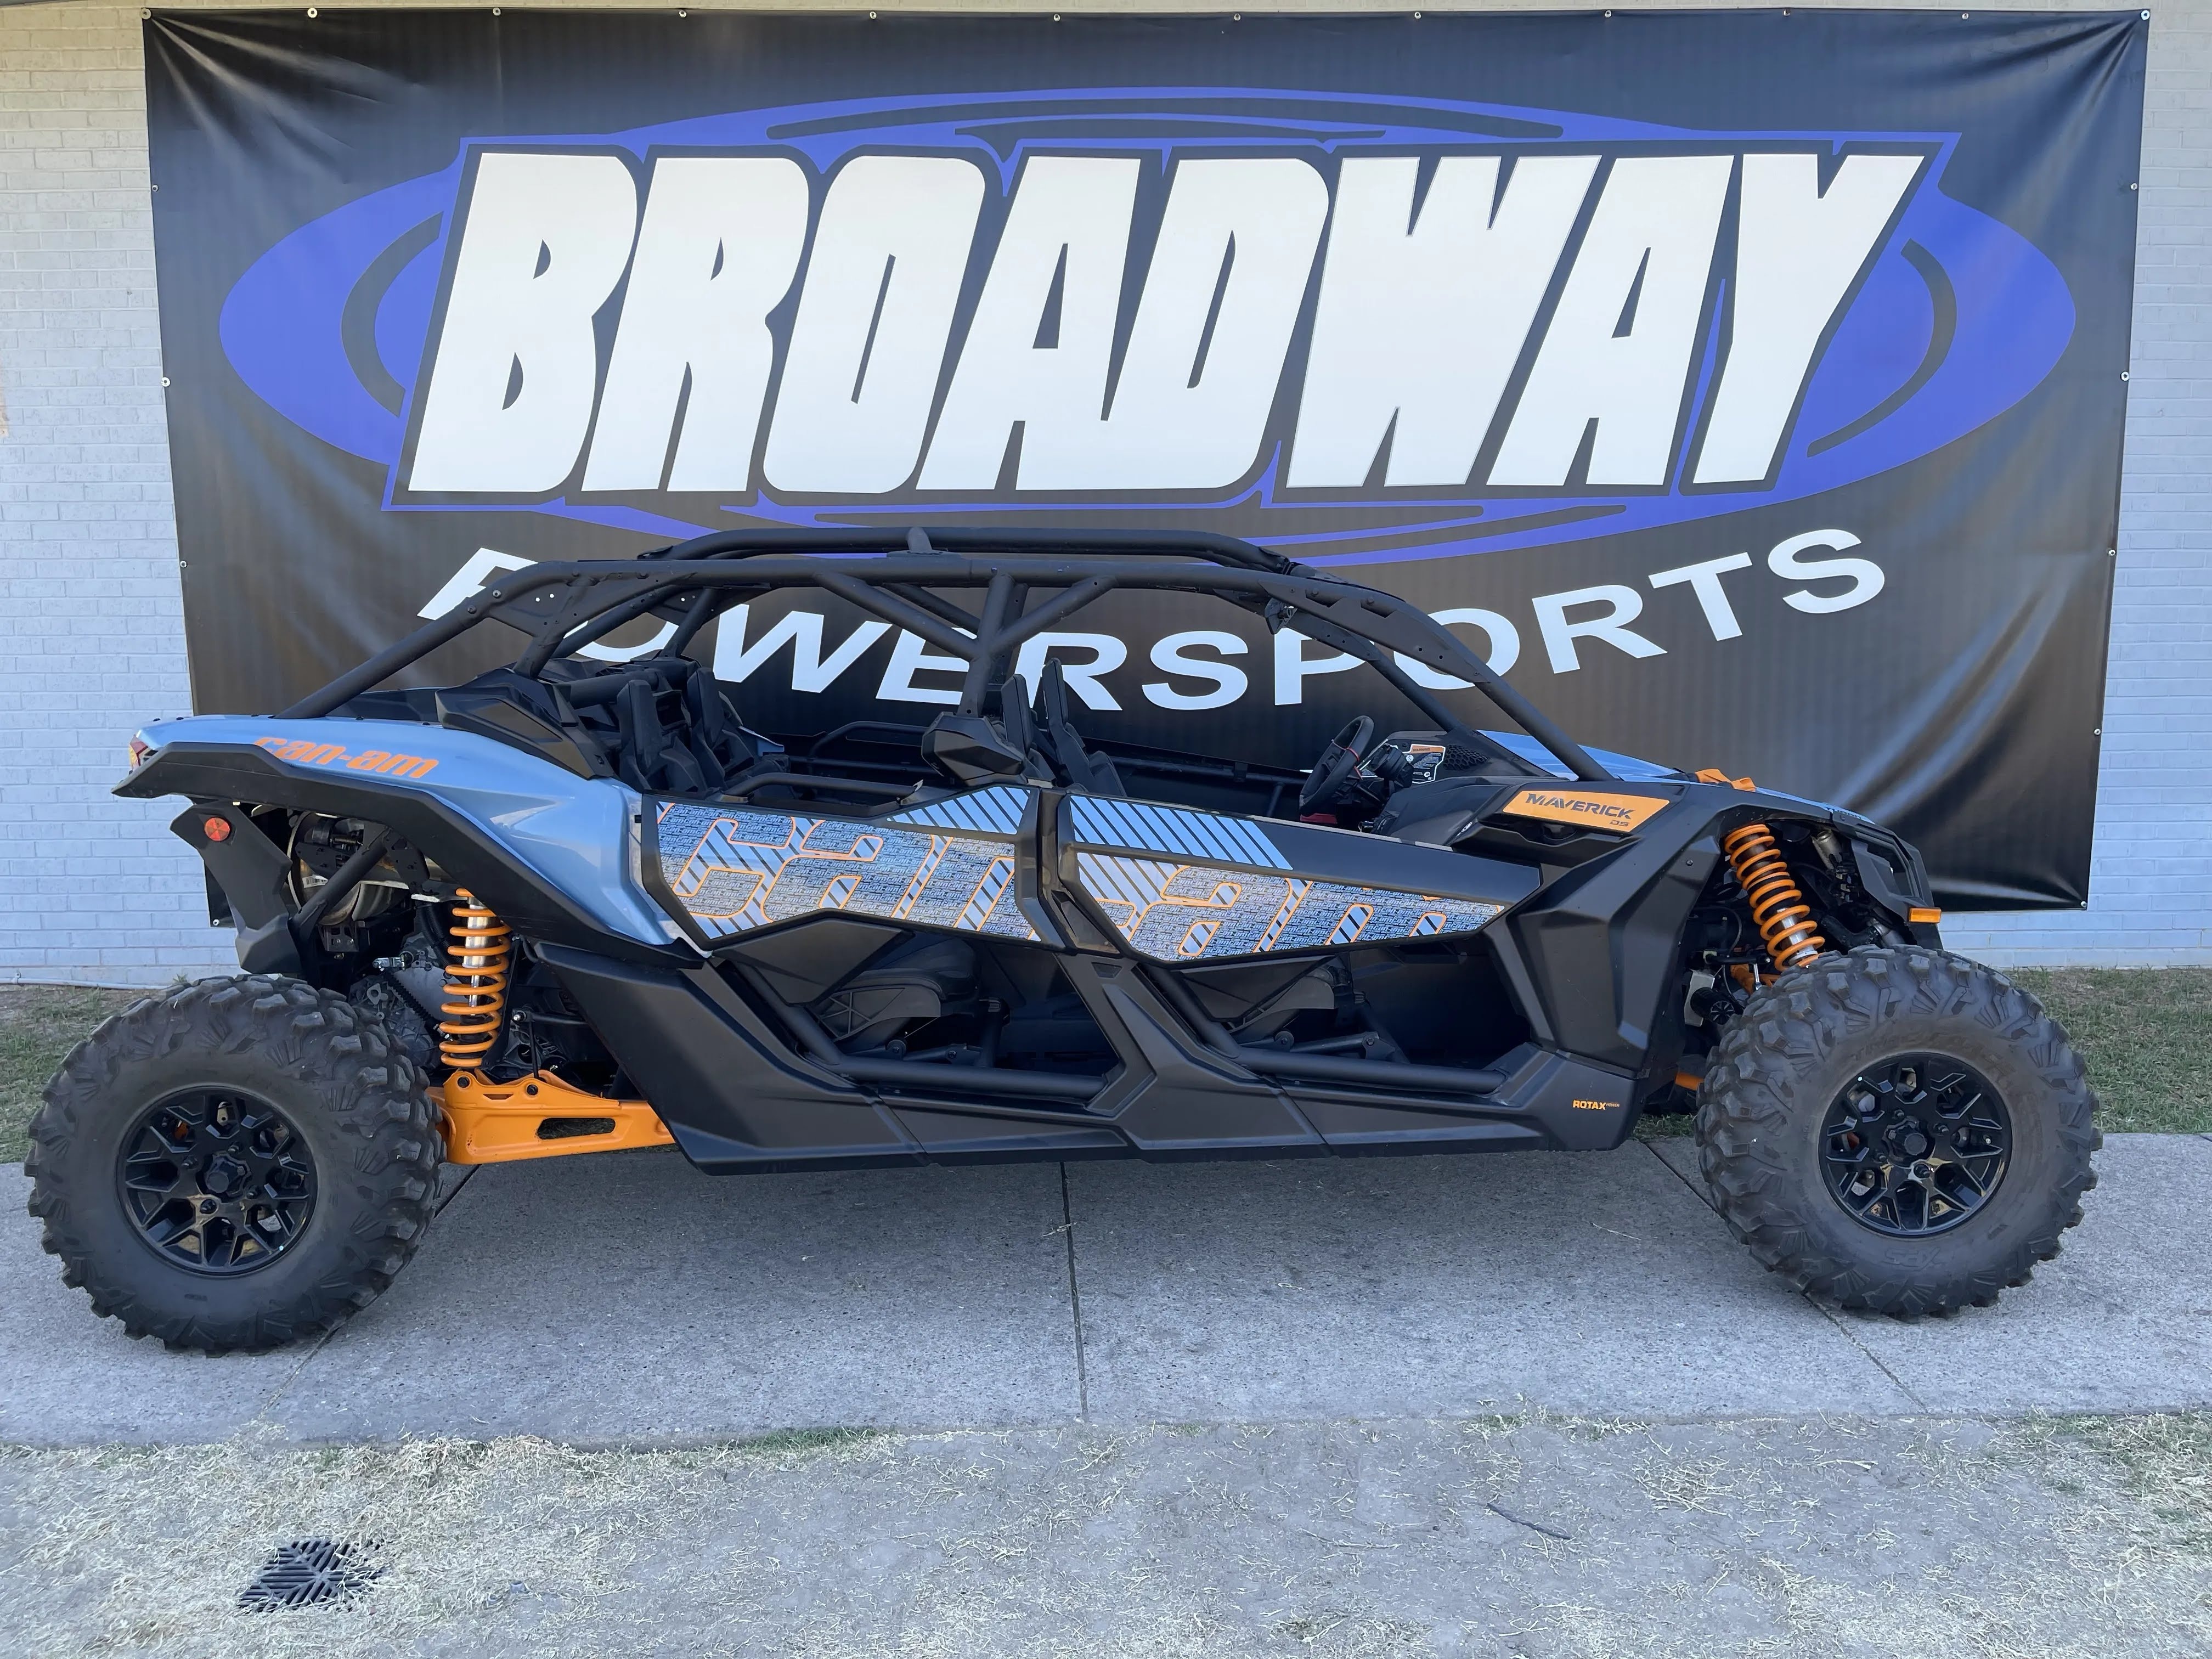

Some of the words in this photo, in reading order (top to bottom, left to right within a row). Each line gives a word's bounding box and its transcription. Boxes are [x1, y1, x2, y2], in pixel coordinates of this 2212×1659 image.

[408, 153, 1925, 494] BROADWAY
[254, 737, 439, 778] can-am
[1525, 793, 1637, 820] MAVERICK
[1572, 1099, 1606, 1110] ROTAX
